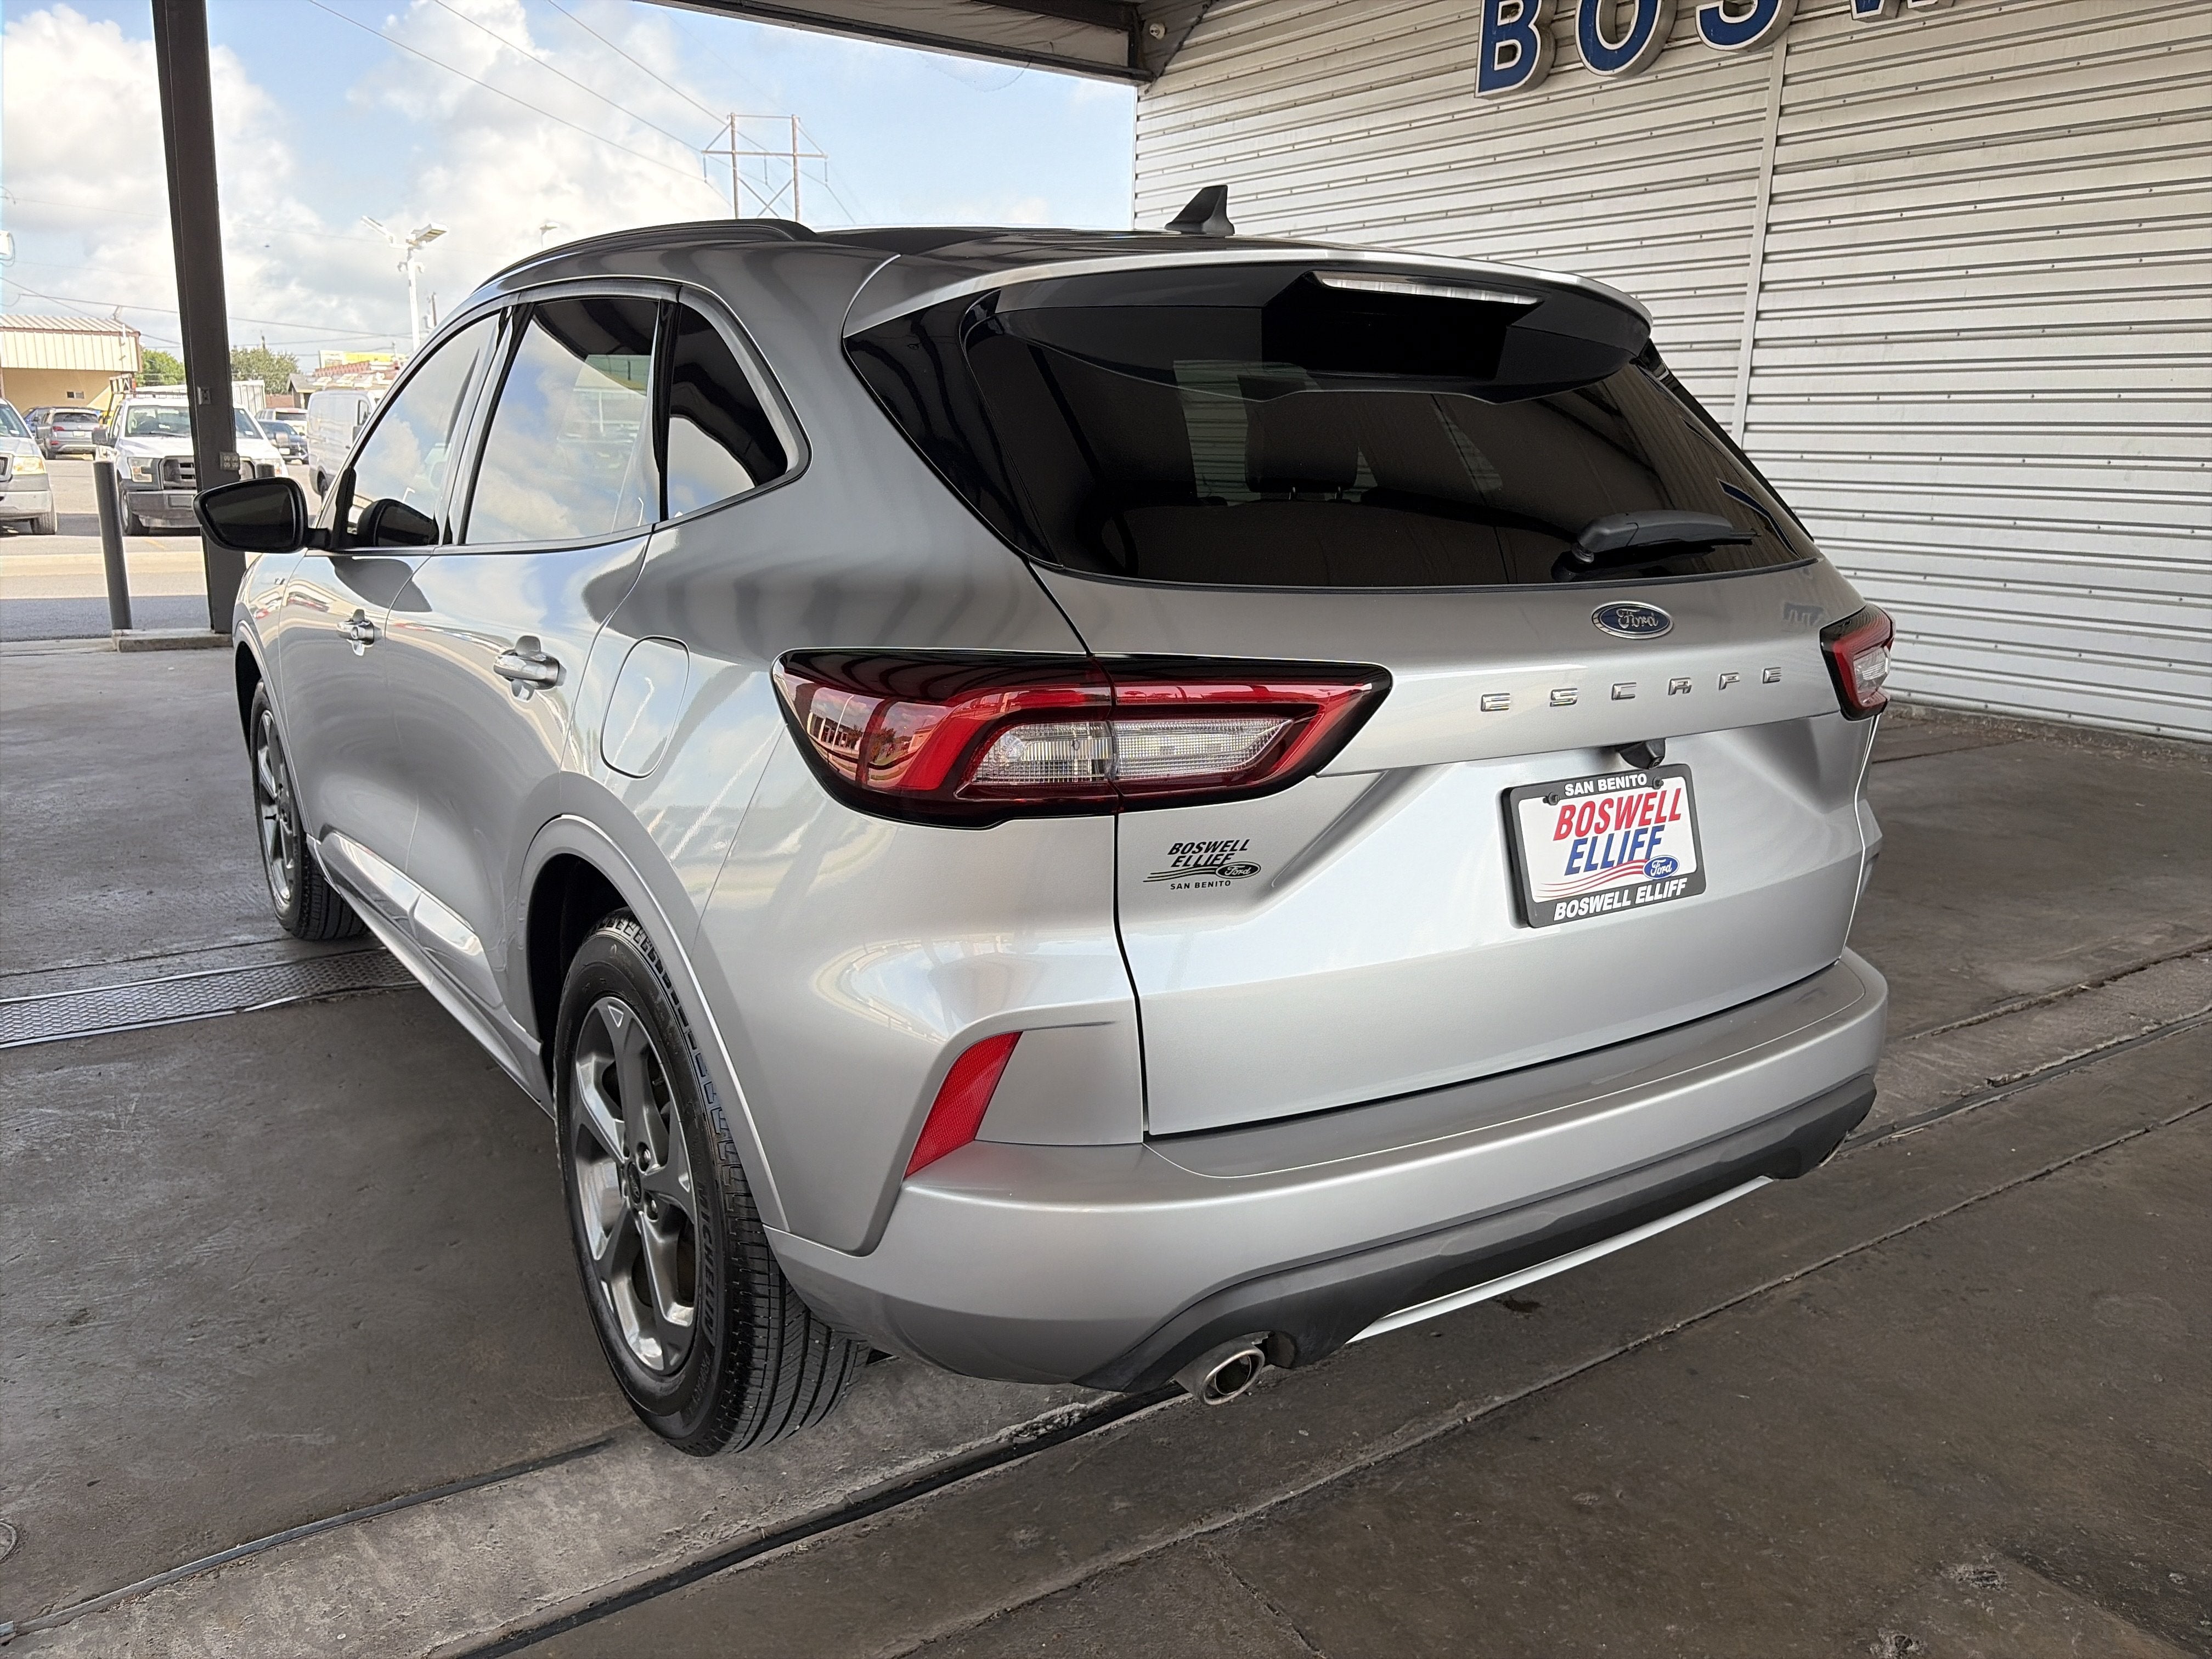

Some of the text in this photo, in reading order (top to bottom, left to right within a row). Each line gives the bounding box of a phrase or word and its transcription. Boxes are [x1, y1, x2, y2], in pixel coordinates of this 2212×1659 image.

[1475, 0, 1940, 99] BOS
[1616, 608, 1660, 630] Ford
[1481, 667, 1782, 713] ESCAPE
[1565, 773, 1647, 797] SAN BENITO
[1553, 788, 1682, 842] BOSWELL
[1167, 839, 1250, 855] BOSWELL
[1170, 853, 1235, 867] ELLIFF
[1564, 824, 1666, 876] ELLIFF
[1194, 880, 1231, 889] BENITO
[1553, 878, 1688, 921] BOSWELL ELLIFF
[697, 1180, 715, 1335] MICHELIN
